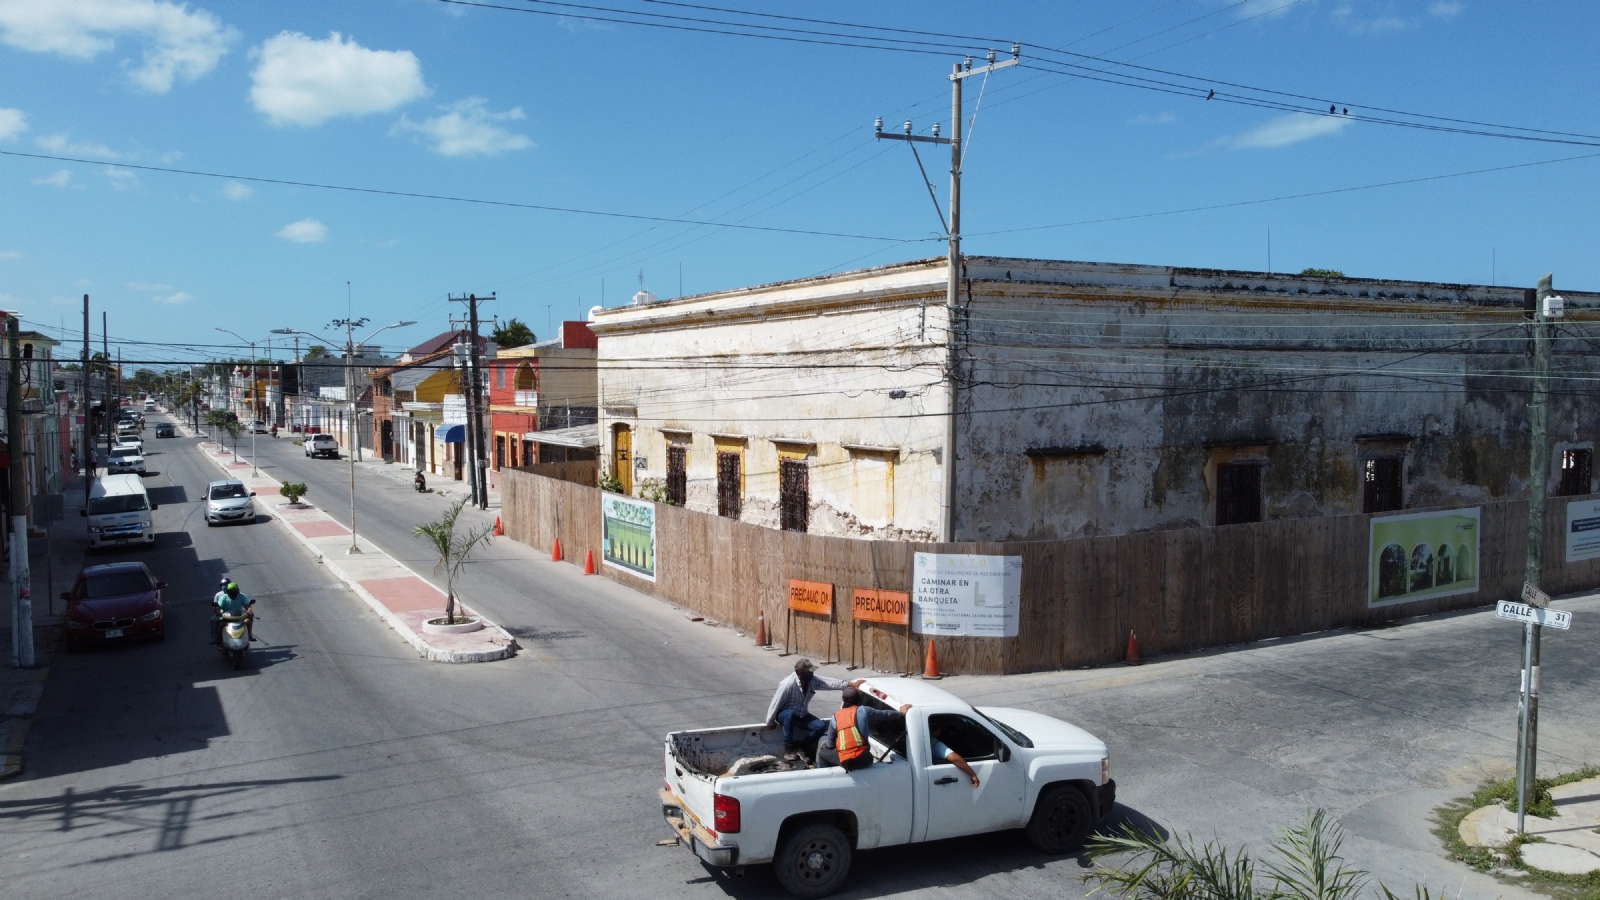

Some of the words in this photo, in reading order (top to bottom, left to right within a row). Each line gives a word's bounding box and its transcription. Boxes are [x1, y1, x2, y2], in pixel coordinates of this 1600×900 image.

[922, 578, 956, 586] CAMINAR
[1526, 586, 1537, 599] CALLE
[856, 597, 906, 614] PRECAUCION
[918, 596, 958, 604] BANQUETA
[1503, 604, 1532, 617] CALLE
[1555, 613, 1565, 622] 31
